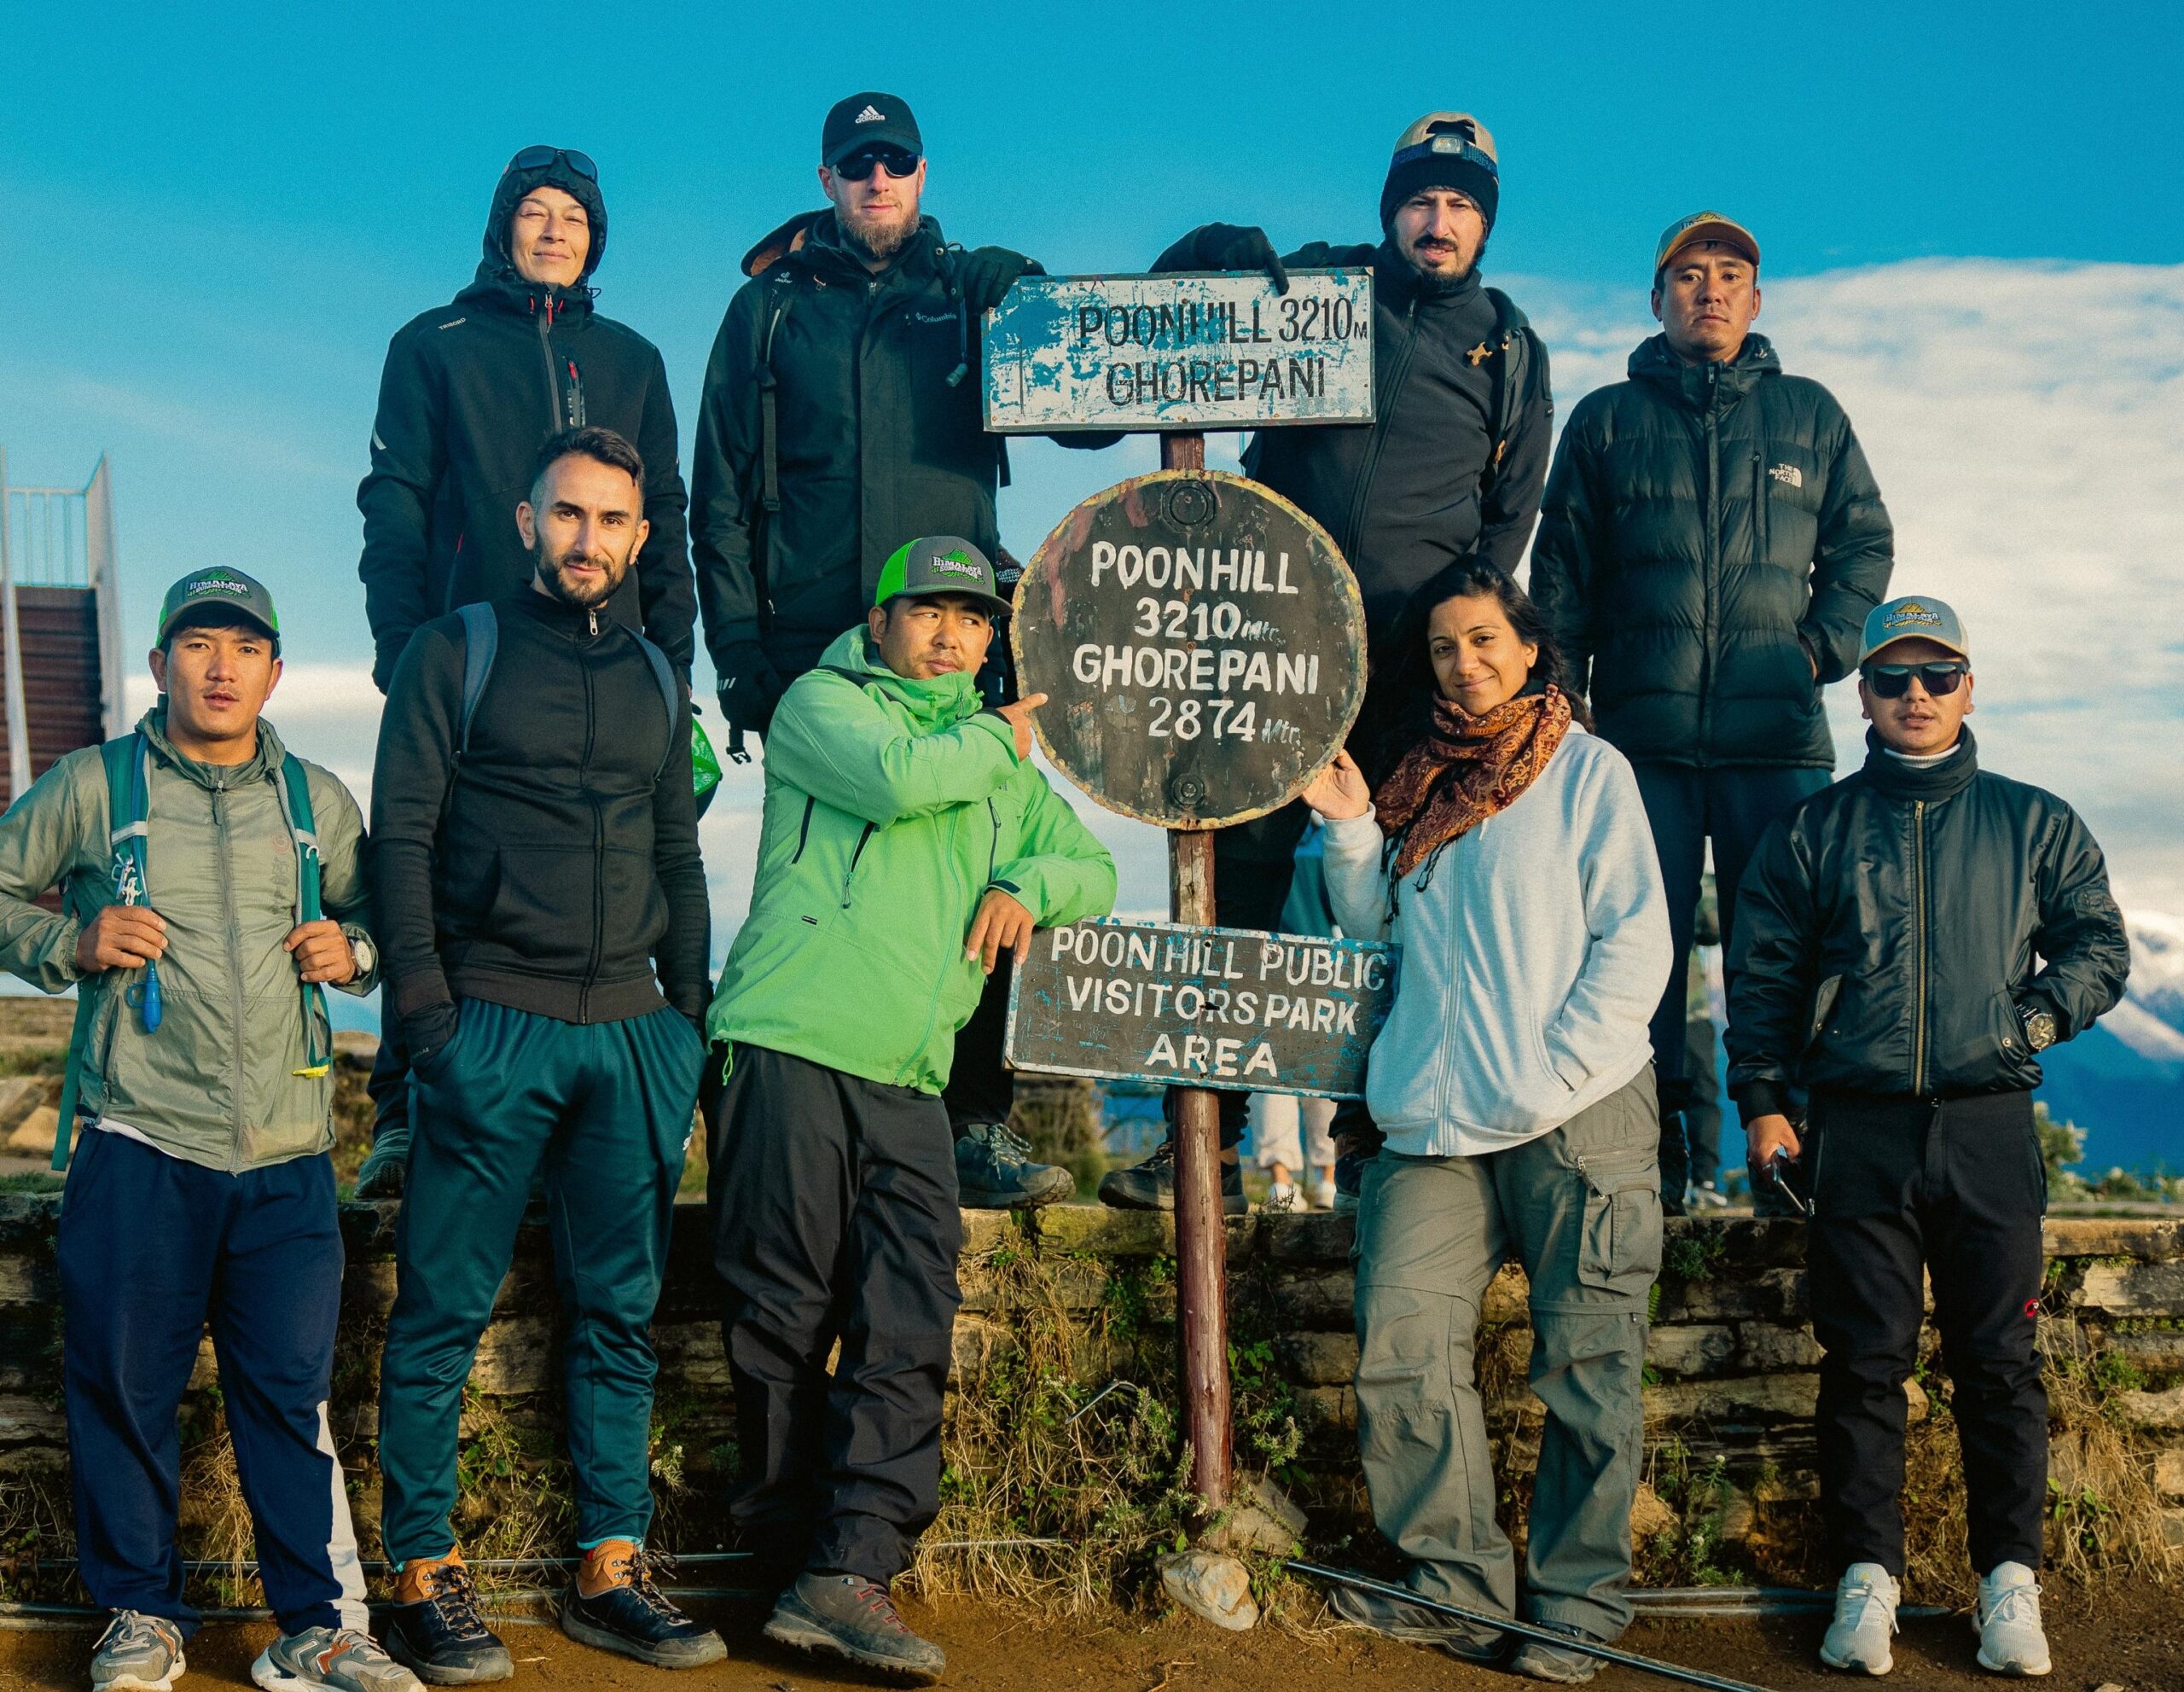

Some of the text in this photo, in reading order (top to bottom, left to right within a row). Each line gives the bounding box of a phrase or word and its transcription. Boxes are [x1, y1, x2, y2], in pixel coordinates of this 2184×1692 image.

[855, 114, 886, 124] adidas
[921, 312, 957, 323] Columbia
[1107, 357, 1325, 406] GHOREPANI
[1072, 644, 1319, 695] GHOREPANI
[1148, 696, 1256, 742] 2874
[1259, 941, 1388, 991] PUBLIC
[1144, 1033, 1278, 1078] AREA
